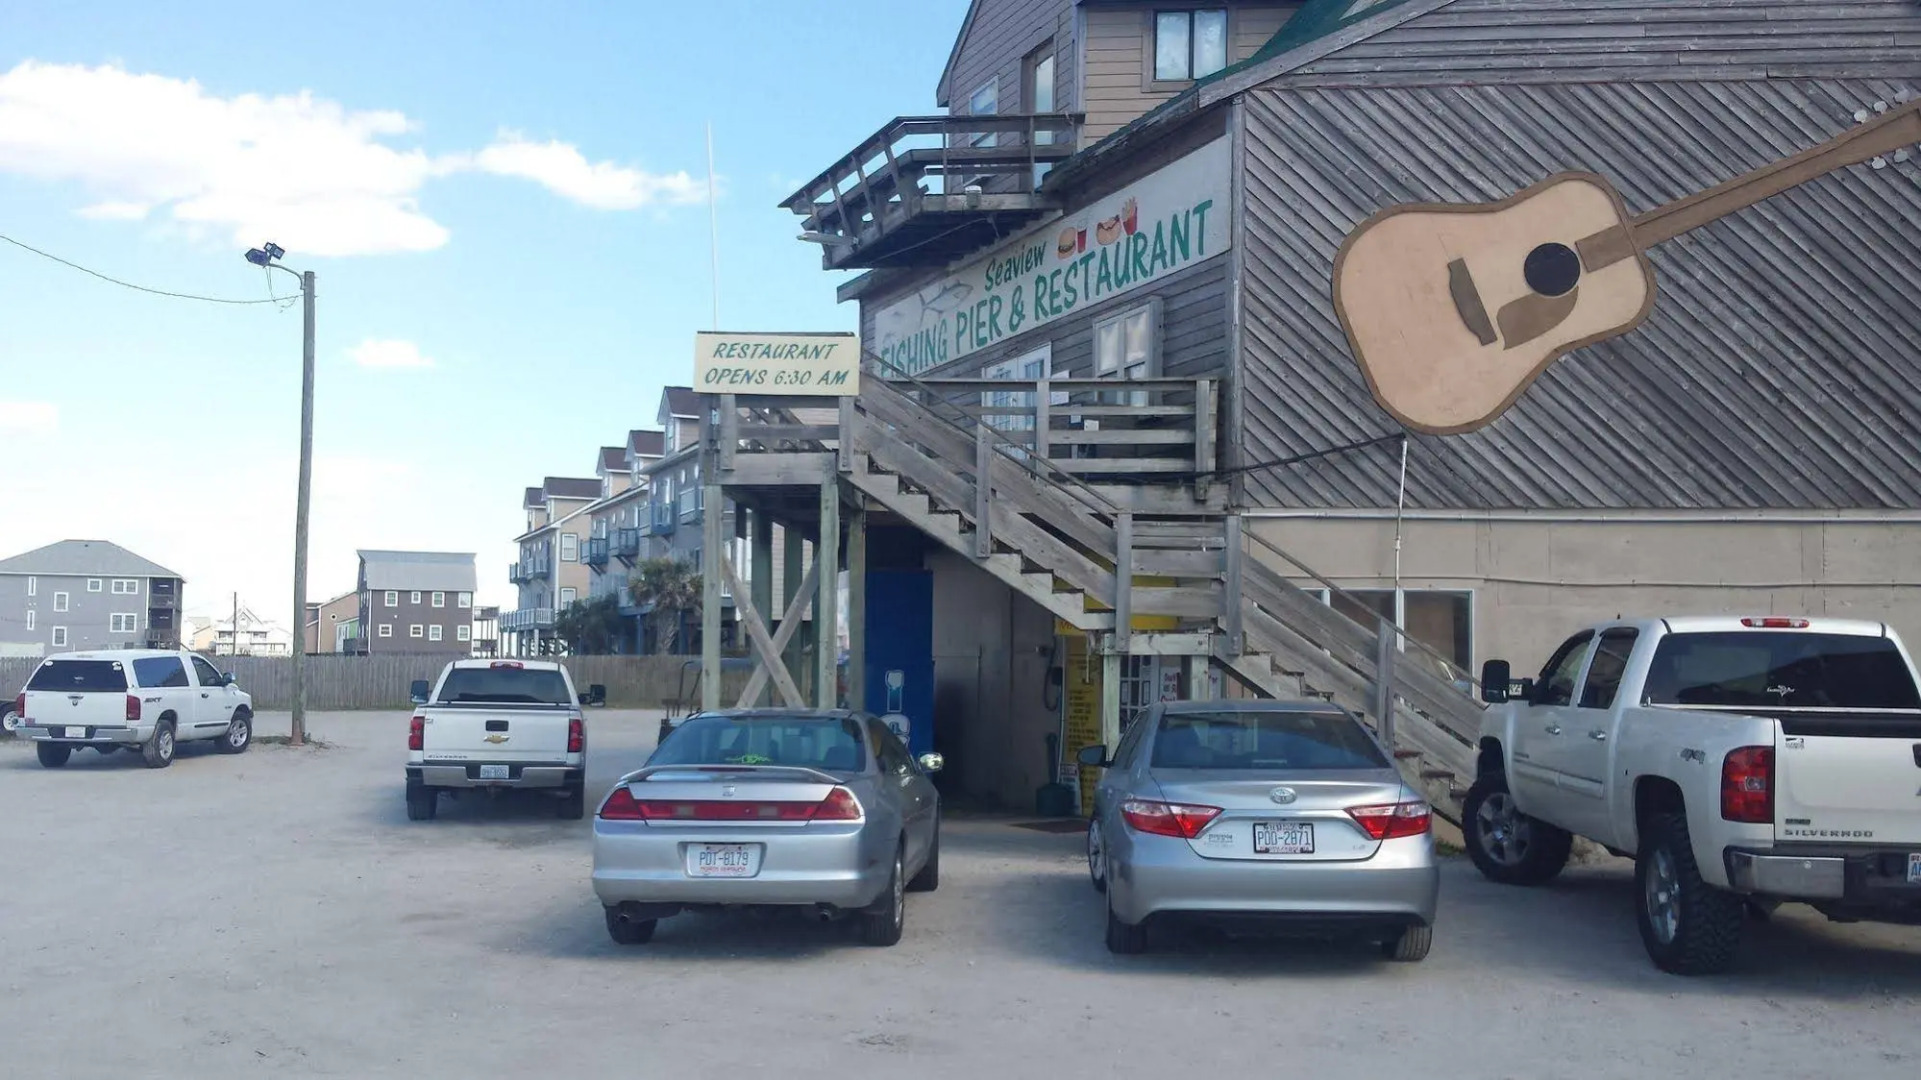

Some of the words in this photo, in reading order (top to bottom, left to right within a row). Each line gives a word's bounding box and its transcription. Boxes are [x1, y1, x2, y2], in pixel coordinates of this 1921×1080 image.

[984, 241, 1047, 292] Seaview
[881, 318, 948, 377] FISHING
[955, 294, 1003, 355] PIER
[1009, 285, 1026, 332] &
[1034, 199, 1213, 322] RESTAURANT
[712, 342, 839, 360] RESTAURANT
[704, 367, 768, 385] OPENS
[774, 370, 812, 385] 6:30
[817, 370, 849, 386] AM
